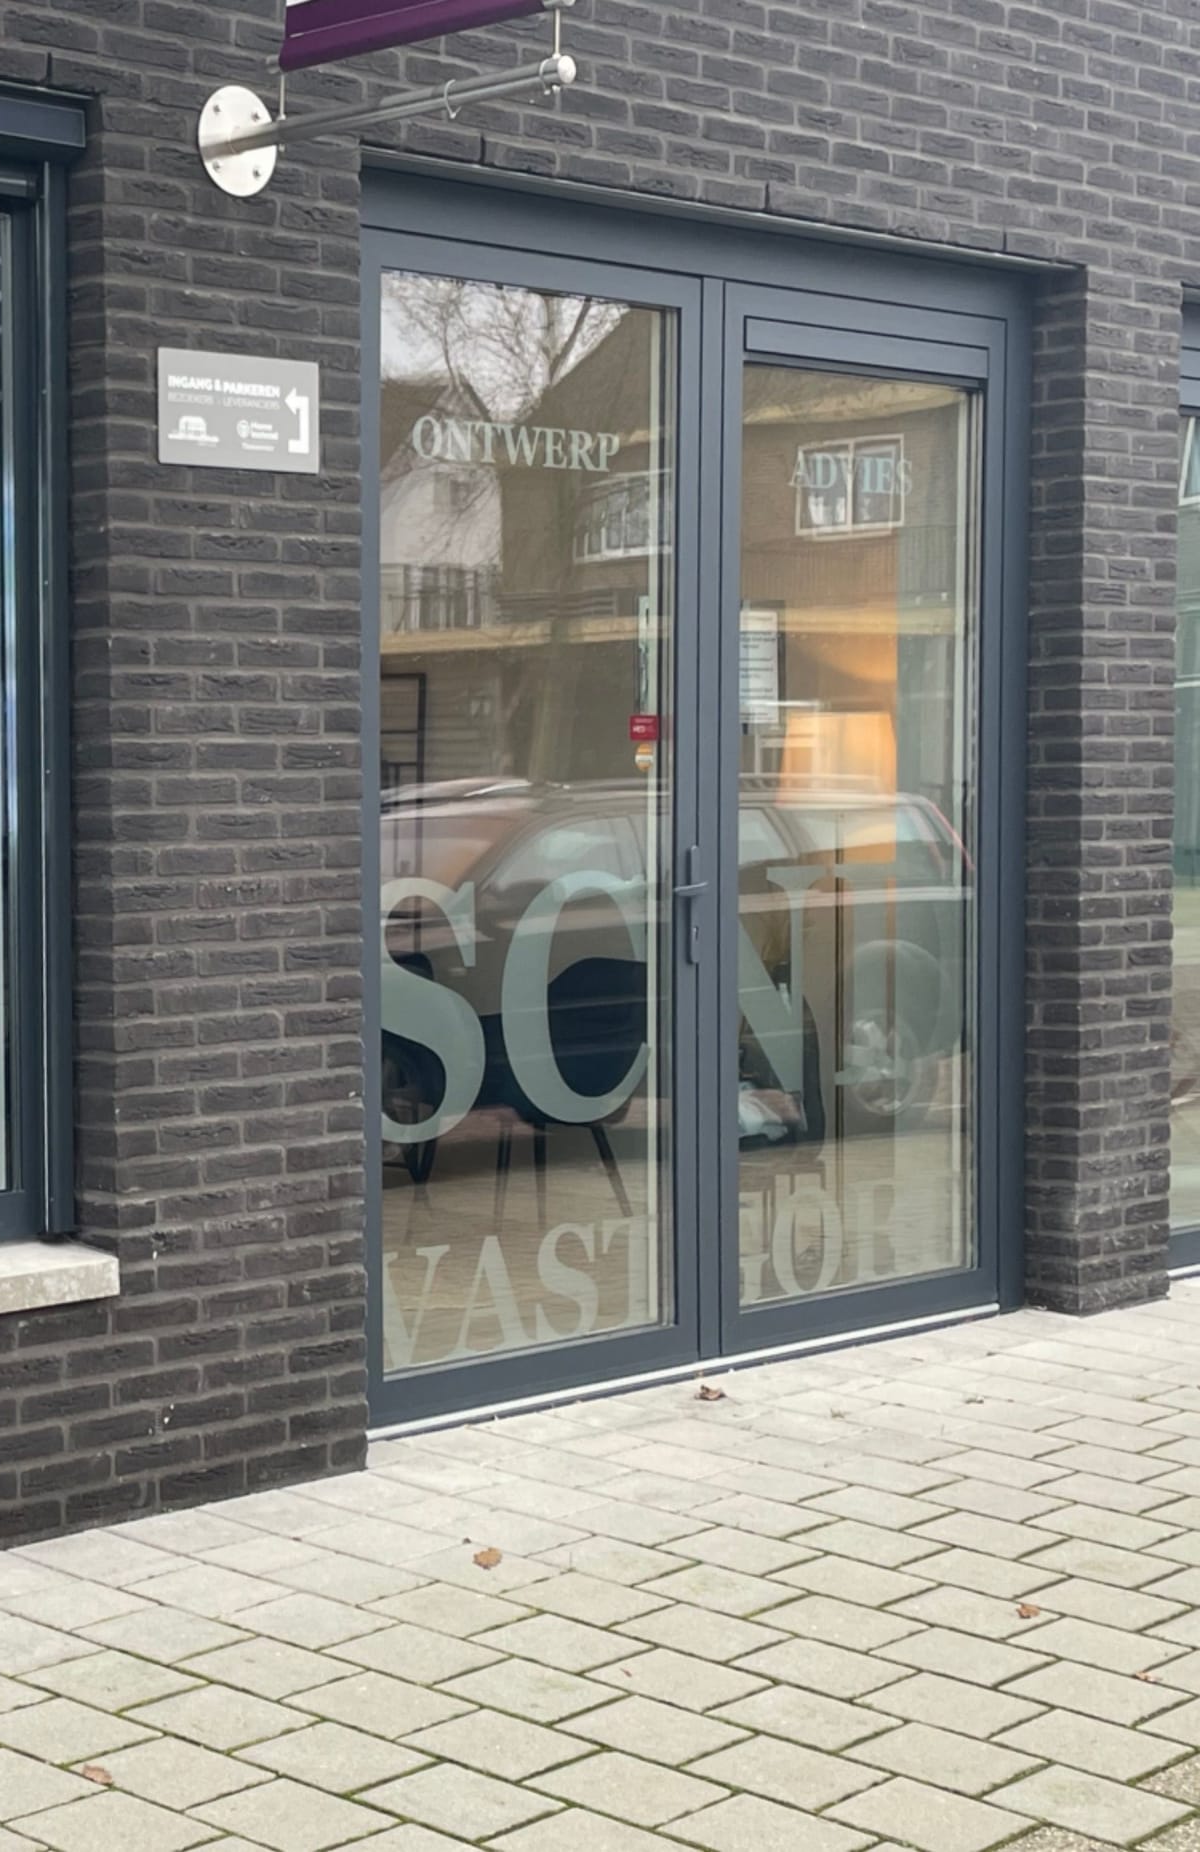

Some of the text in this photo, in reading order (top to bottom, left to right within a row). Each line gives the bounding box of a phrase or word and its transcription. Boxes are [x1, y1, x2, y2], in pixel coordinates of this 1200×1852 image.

[168, 375, 213, 391] INGANG
[223, 381, 281, 398] PARKEREN
[411, 415, 621, 474] ONTWERP
[787, 452, 914, 497] ADVIES
